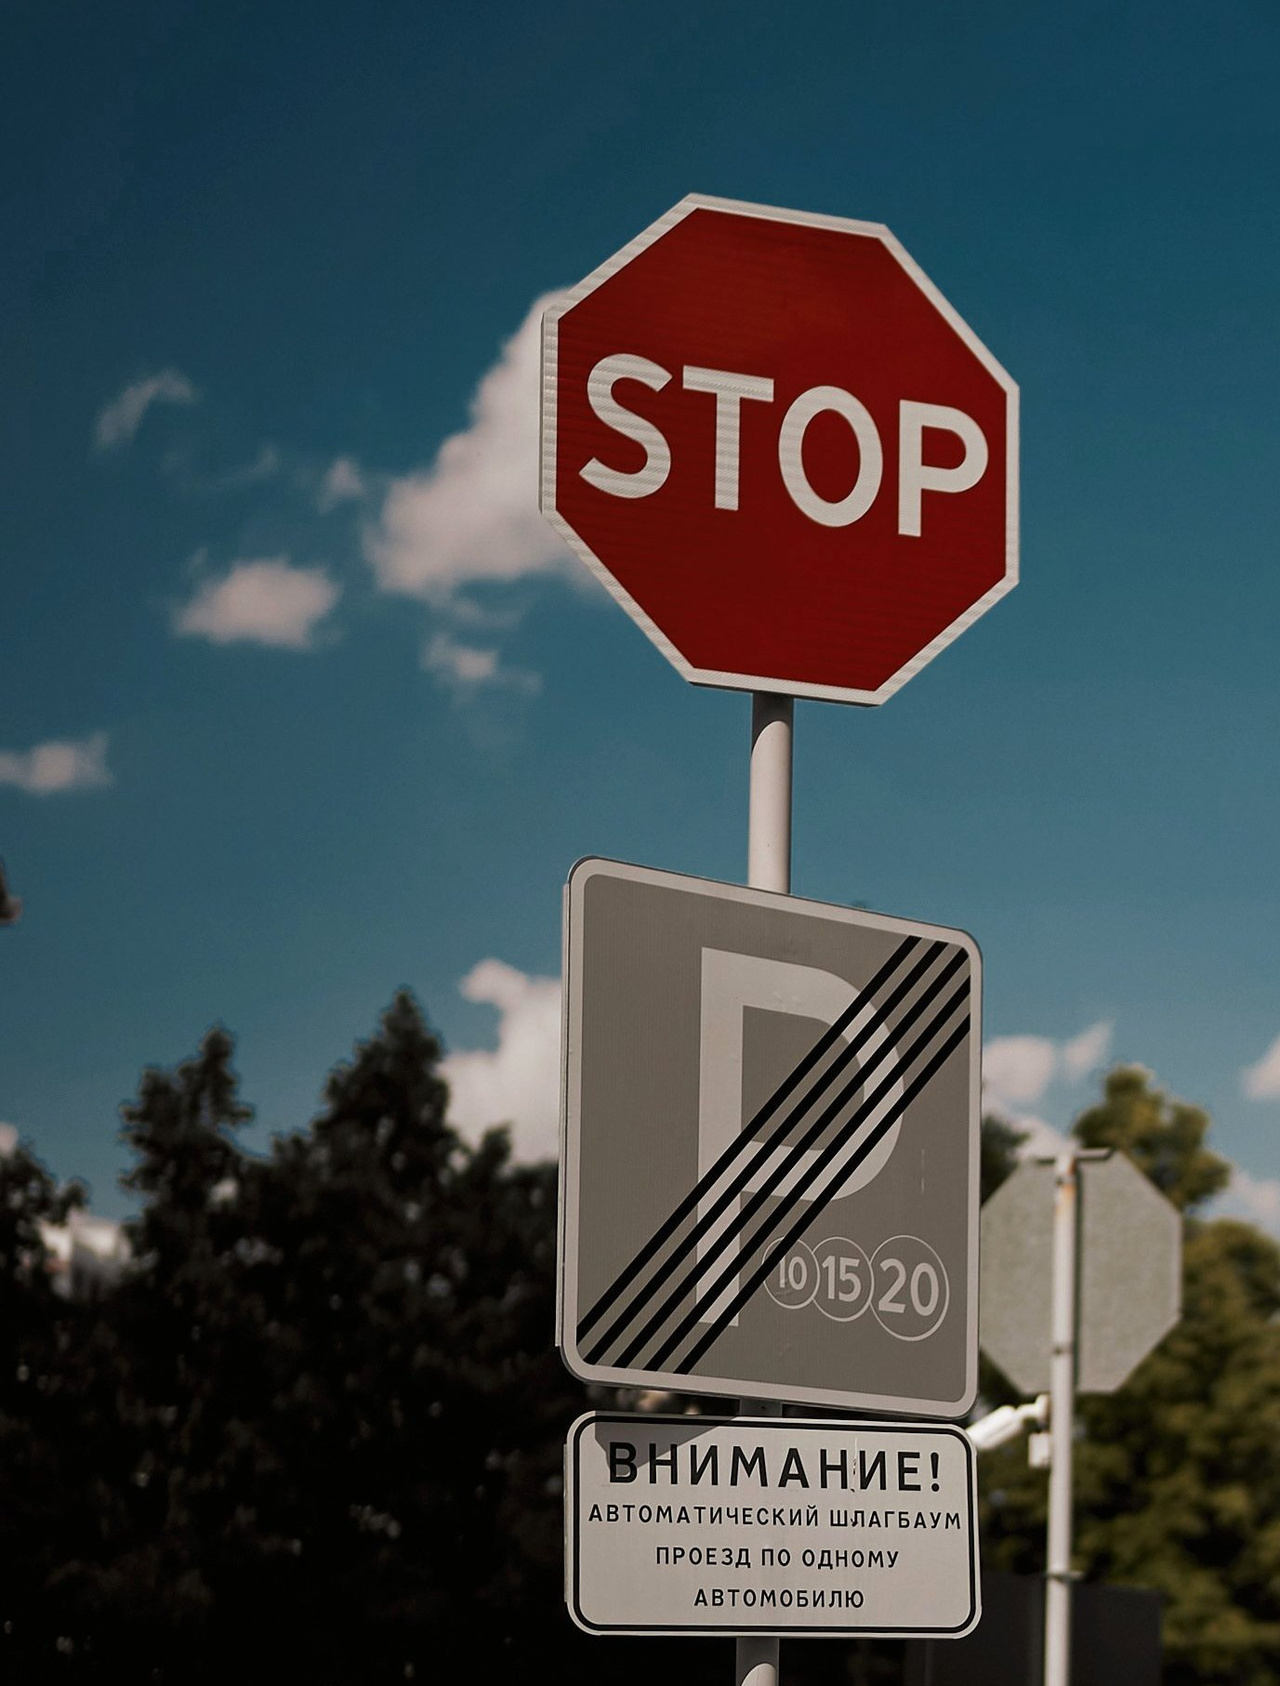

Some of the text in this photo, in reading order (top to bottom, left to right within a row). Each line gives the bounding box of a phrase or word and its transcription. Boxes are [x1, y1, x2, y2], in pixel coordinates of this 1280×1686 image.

[578, 352, 989, 538] STOP
[695, 947, 905, 1327] P
[778, 1255, 939, 1317] 10 15 20
[608, 1441, 940, 1493] ВНИМАНИЕ!
[588, 1503, 962, 1530] АВТОМАТИЧЕСКИЙ ШЛАГБАУМ
[656, 1546, 899, 1570] ПРОЕЗД ПО ОДНОМУ
[693, 1588, 864, 1609] АВТОМОБИЛЮ
